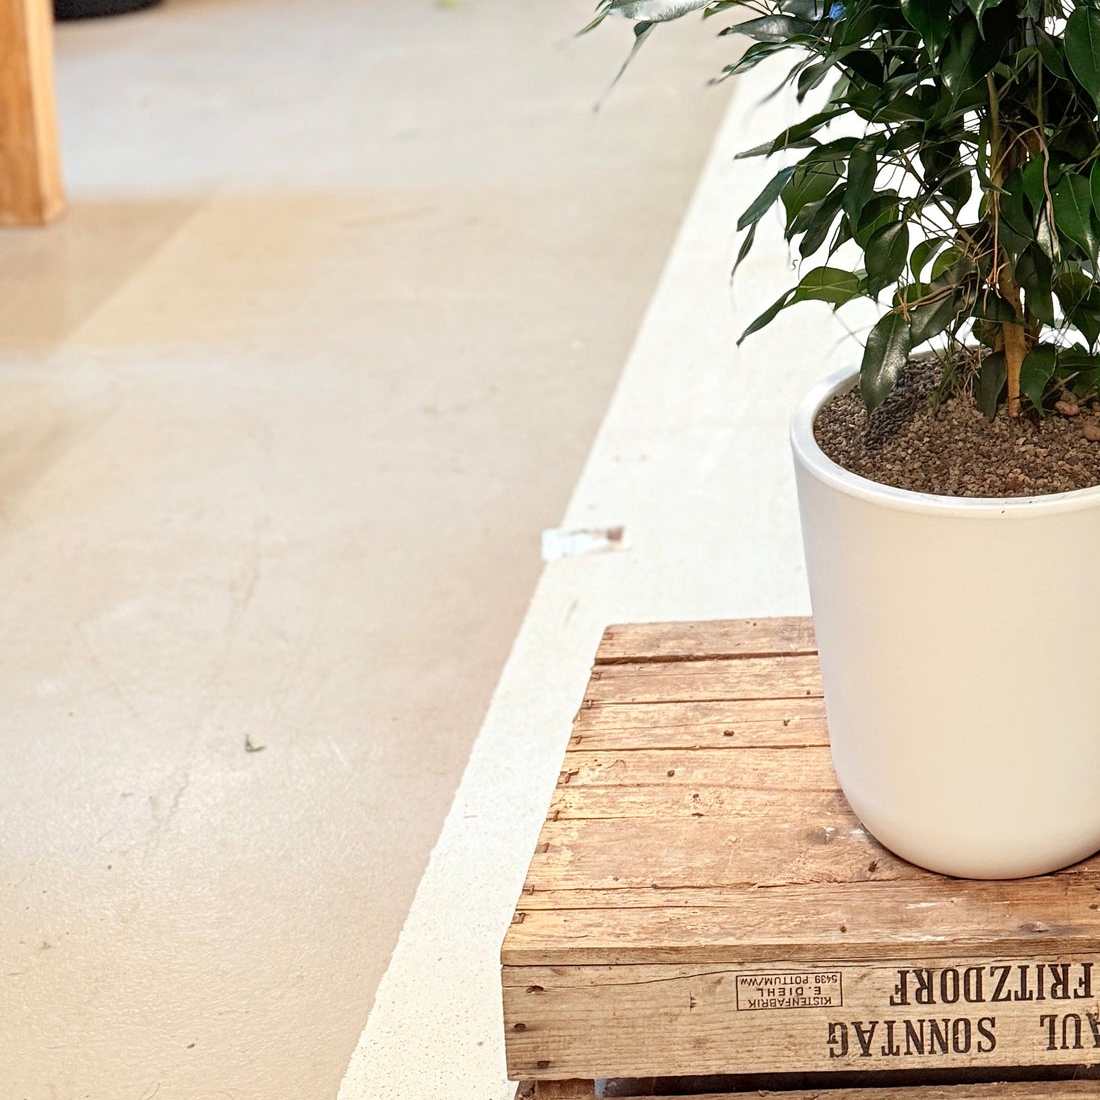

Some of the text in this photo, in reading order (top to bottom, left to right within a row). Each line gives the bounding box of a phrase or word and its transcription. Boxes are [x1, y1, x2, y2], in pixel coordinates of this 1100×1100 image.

[814, 974, 838, 984] 5439
[889, 963, 1094, 1006] FRITZDORF
[756, 986, 821, 997] E. DIEHL
[747, 996, 832, 1008] KISTENFABRIK
[826, 1016, 996, 1059] SONNTAG
